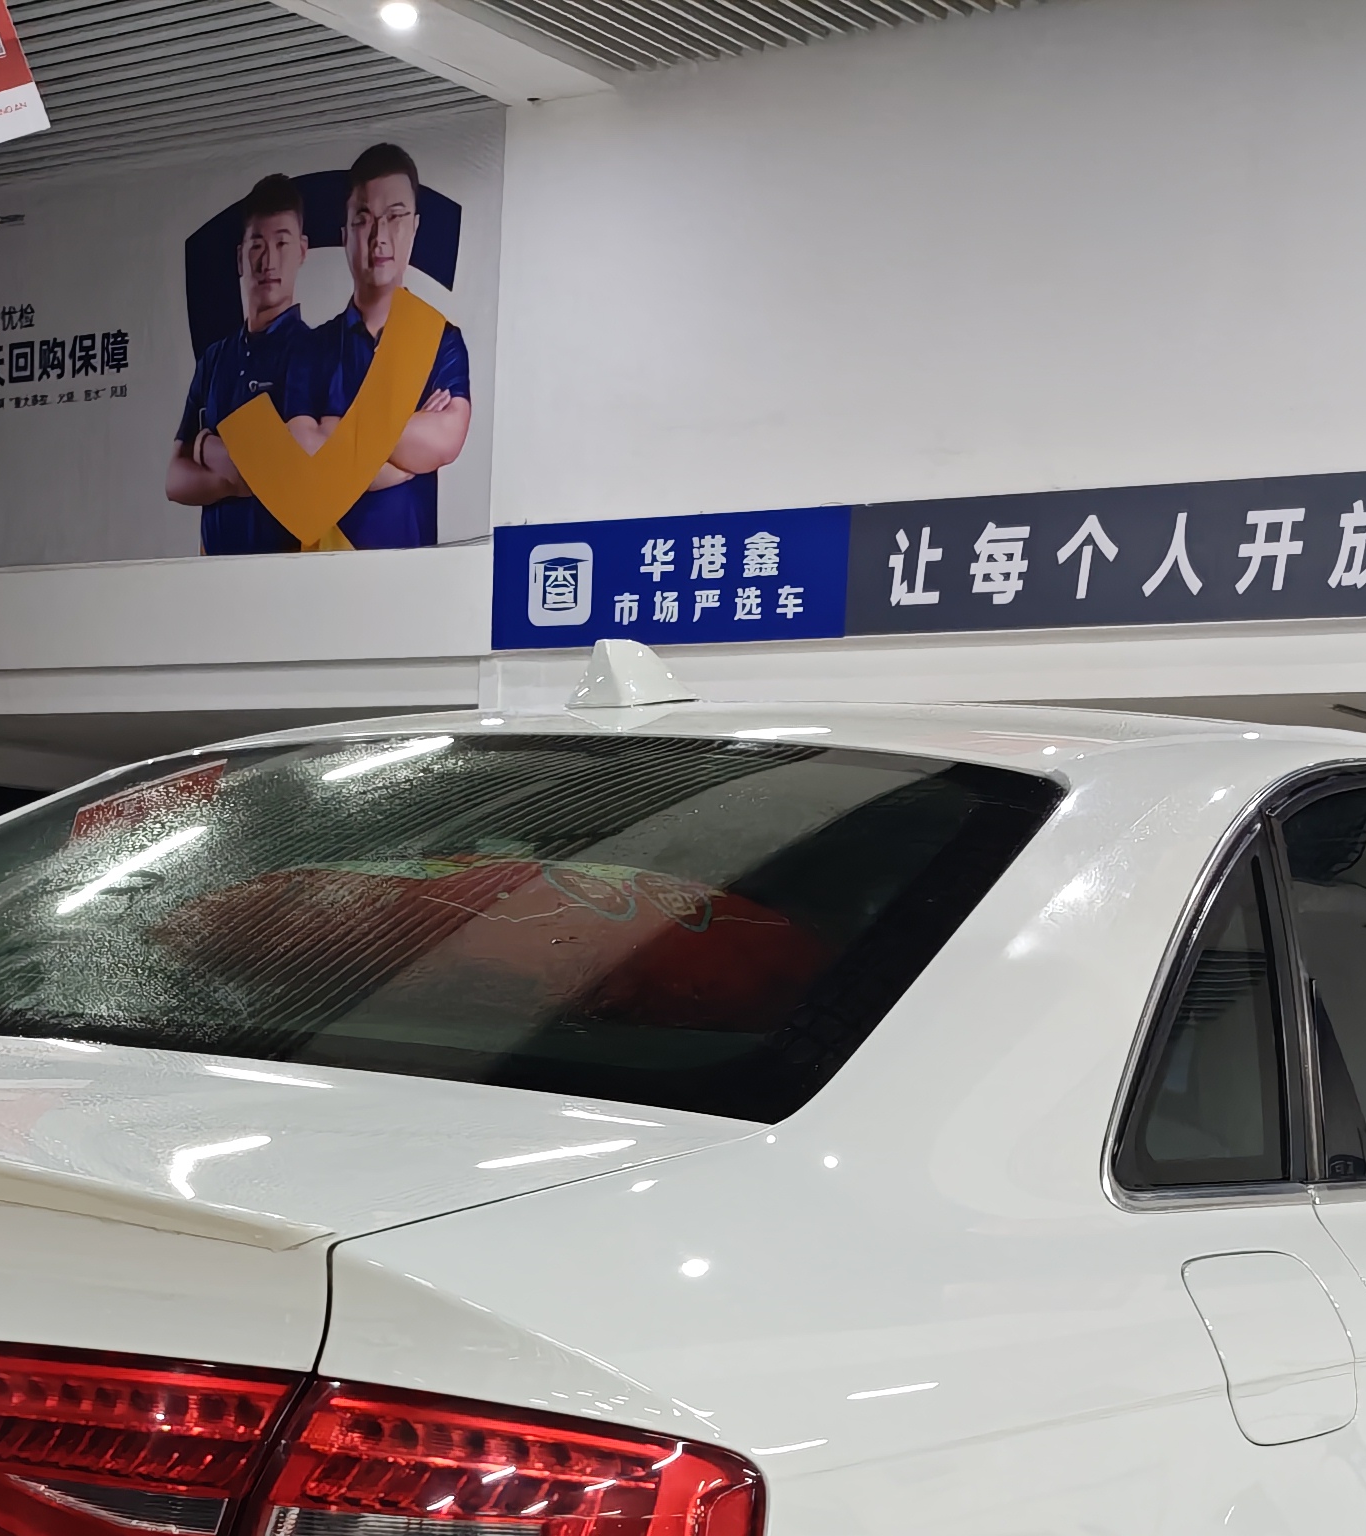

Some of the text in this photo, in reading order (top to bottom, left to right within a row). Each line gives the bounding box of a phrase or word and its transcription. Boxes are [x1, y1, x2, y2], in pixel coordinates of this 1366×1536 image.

[640, 531, 782, 583] 华港鑫
[613, 585, 805, 626] 市场严选车
